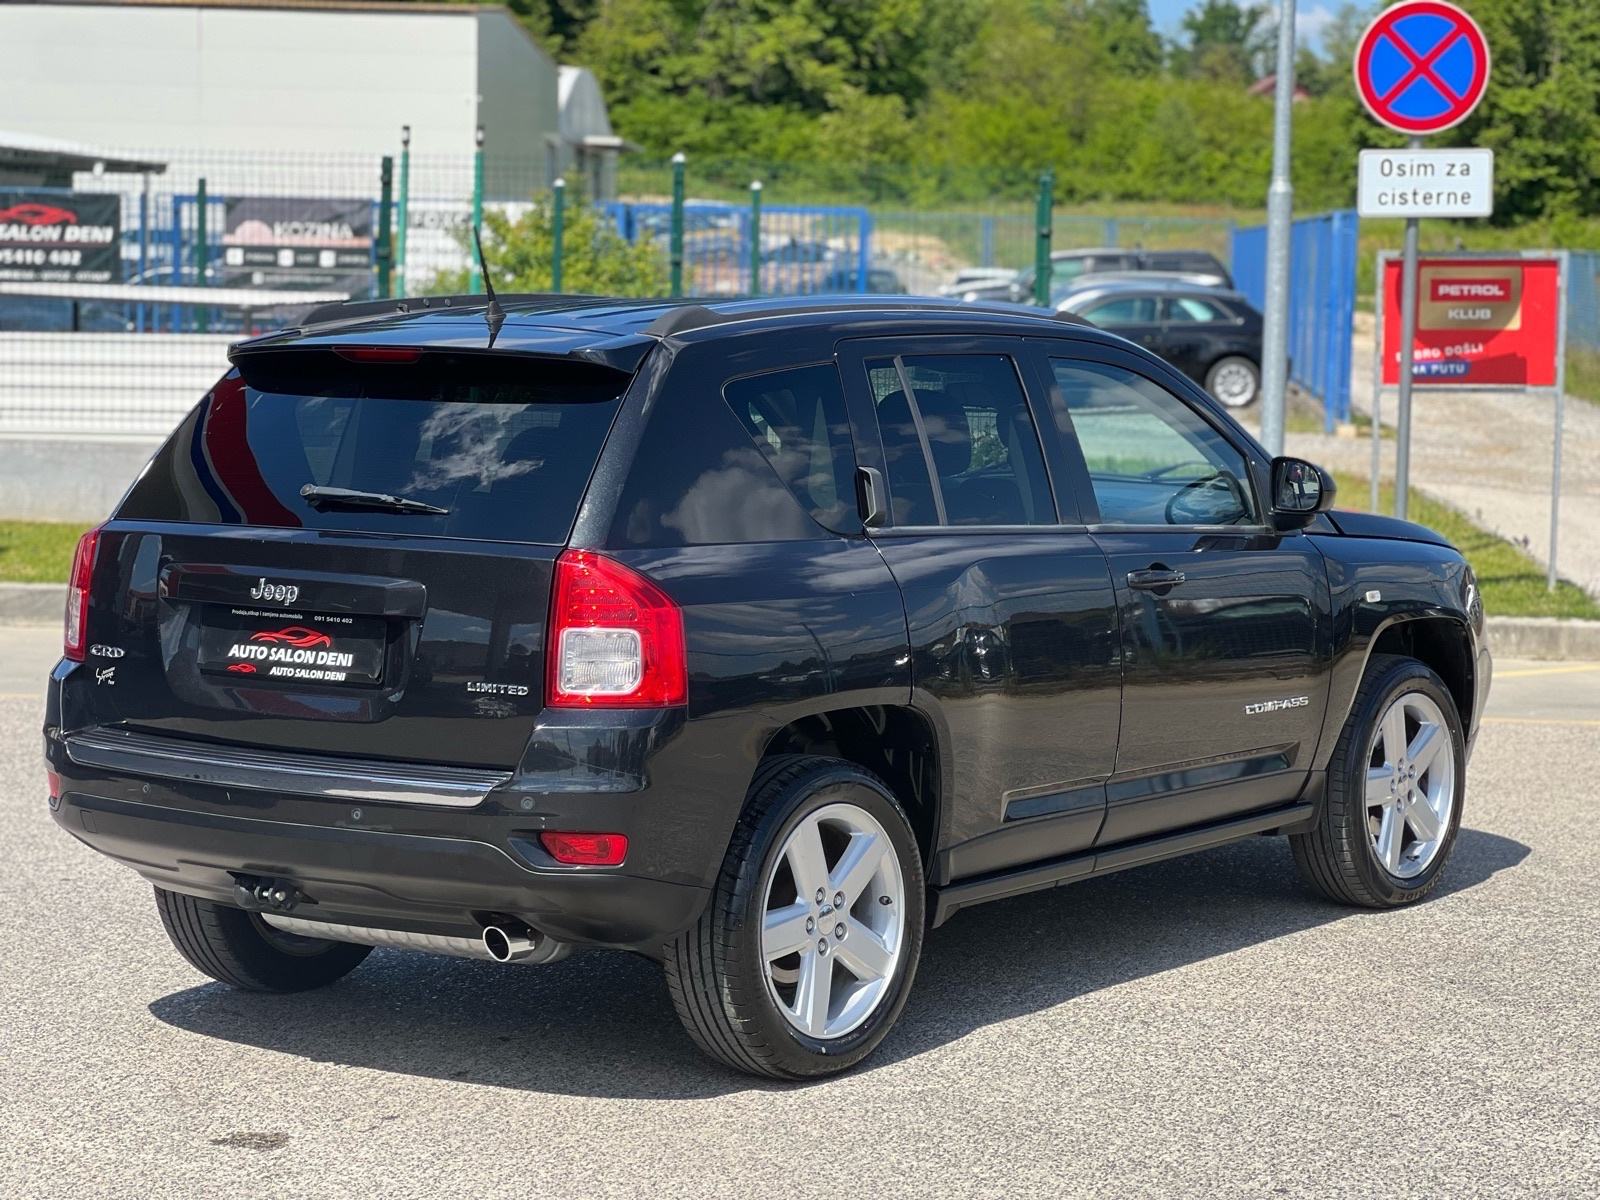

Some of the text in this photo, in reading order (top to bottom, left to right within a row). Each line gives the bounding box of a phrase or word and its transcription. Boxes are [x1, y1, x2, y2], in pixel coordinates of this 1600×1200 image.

[1380, 158, 1471, 177] Osim za
[1377, 187, 1471, 206] cisterne
[64, 225, 114, 243] DENI
[1437, 284, 1504, 296] PETROL
[1448, 308, 1491, 320] KLUB
[1430, 363, 1466, 375] PUTU
[250, 577, 299, 606] Jeep
[228, 644, 354, 667] AUTO SALON DENI
[269, 666, 347, 682] AUTO SALON DENI
[467, 681, 529, 696] LIMITED
[1245, 696, 1309, 715] COMPASS
